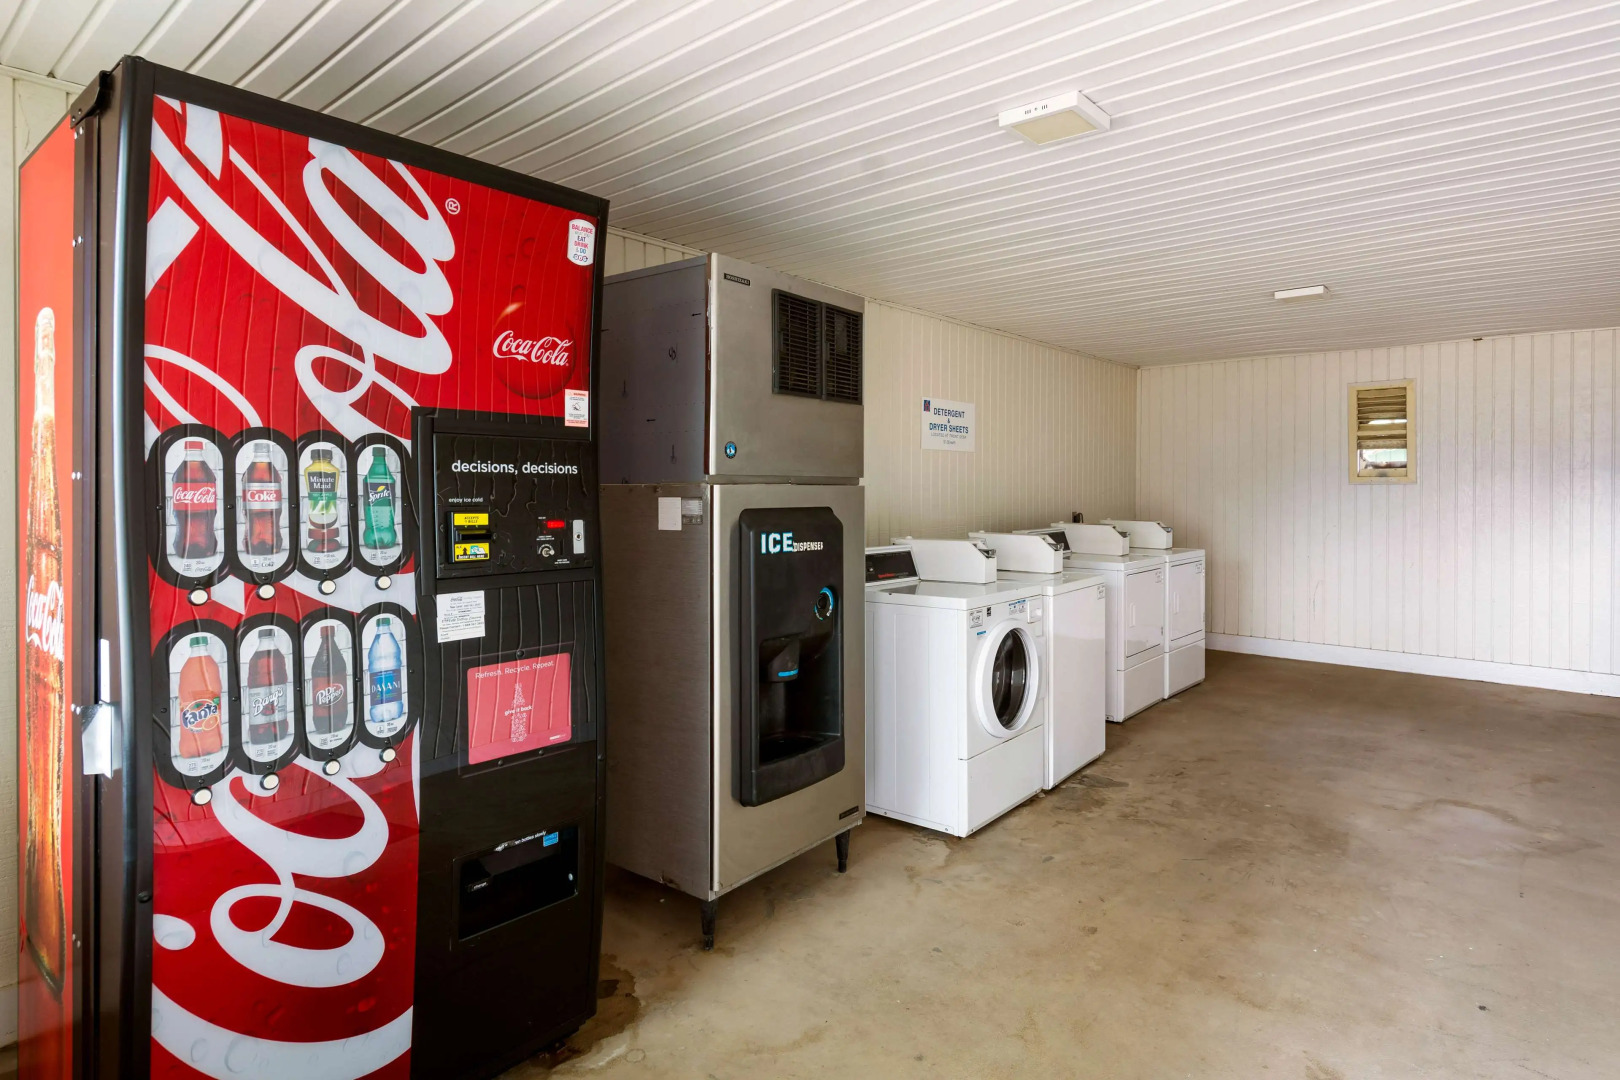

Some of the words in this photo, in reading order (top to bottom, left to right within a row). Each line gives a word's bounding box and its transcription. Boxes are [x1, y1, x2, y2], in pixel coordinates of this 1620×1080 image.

[571, 224, 593, 234] BALANCE
[493, 330, 573, 366] Coca-Cola
[933, 407, 965, 419] DETERGENT
[929, 422, 948, 432] DRYER
[948, 424, 969, 434] SHEETS
[451, 460, 518, 475] decisions,
[522, 462, 578, 474] decisions
[310, 475, 335, 483] Minute
[173, 486, 215, 504] Coca-Cola
[247, 490, 277, 502] Coke
[368, 489, 391, 502] Sprite
[761, 531, 794, 554] ICE
[25, 574, 65, 662] Coca-Cola
[475, 670, 502, 679] Refresh.
[504, 665, 531, 675] Recycle.
[325, 685, 337, 695] Dr
[371, 680, 401, 694] DASANI
[252, 687, 284, 717] Barq's
[317, 689, 342, 705] Pepper
[181, 703, 219, 728] Fanta
